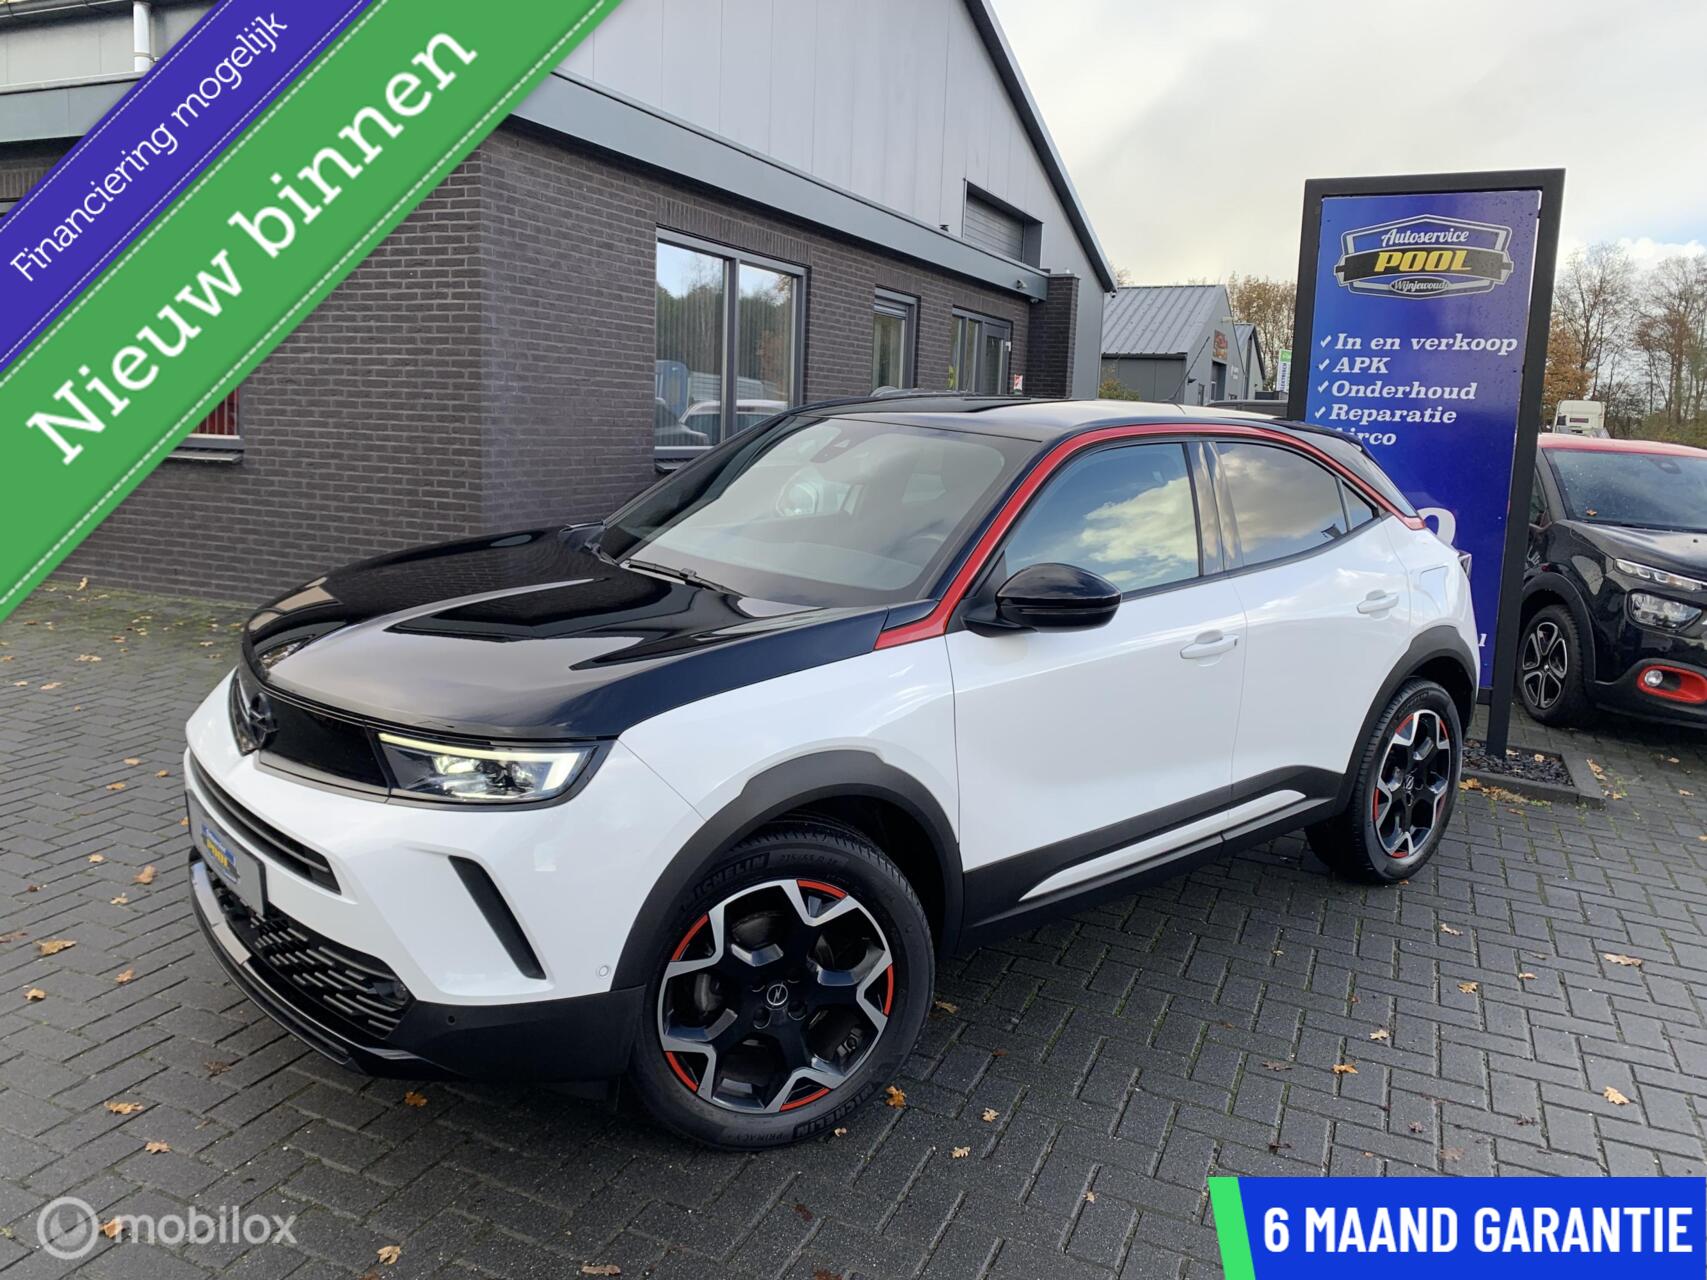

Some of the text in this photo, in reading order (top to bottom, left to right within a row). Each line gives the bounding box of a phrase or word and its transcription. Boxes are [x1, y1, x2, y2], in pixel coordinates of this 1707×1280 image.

[1381, 228, 1470, 247] Autoservice
[1374, 250, 1472, 272] POOL
[1335, 333, 1518, 355] In en verkoop
[1332, 357, 1391, 373] APK
[1331, 380, 1478, 400] Onderhoud
[1329, 403, 1457, 425] Reparatie
[1335, 427, 1397, 445] rco
[687, 855, 767, 907] ICHELIN
[796, 1083, 874, 1138] MICHELIN
